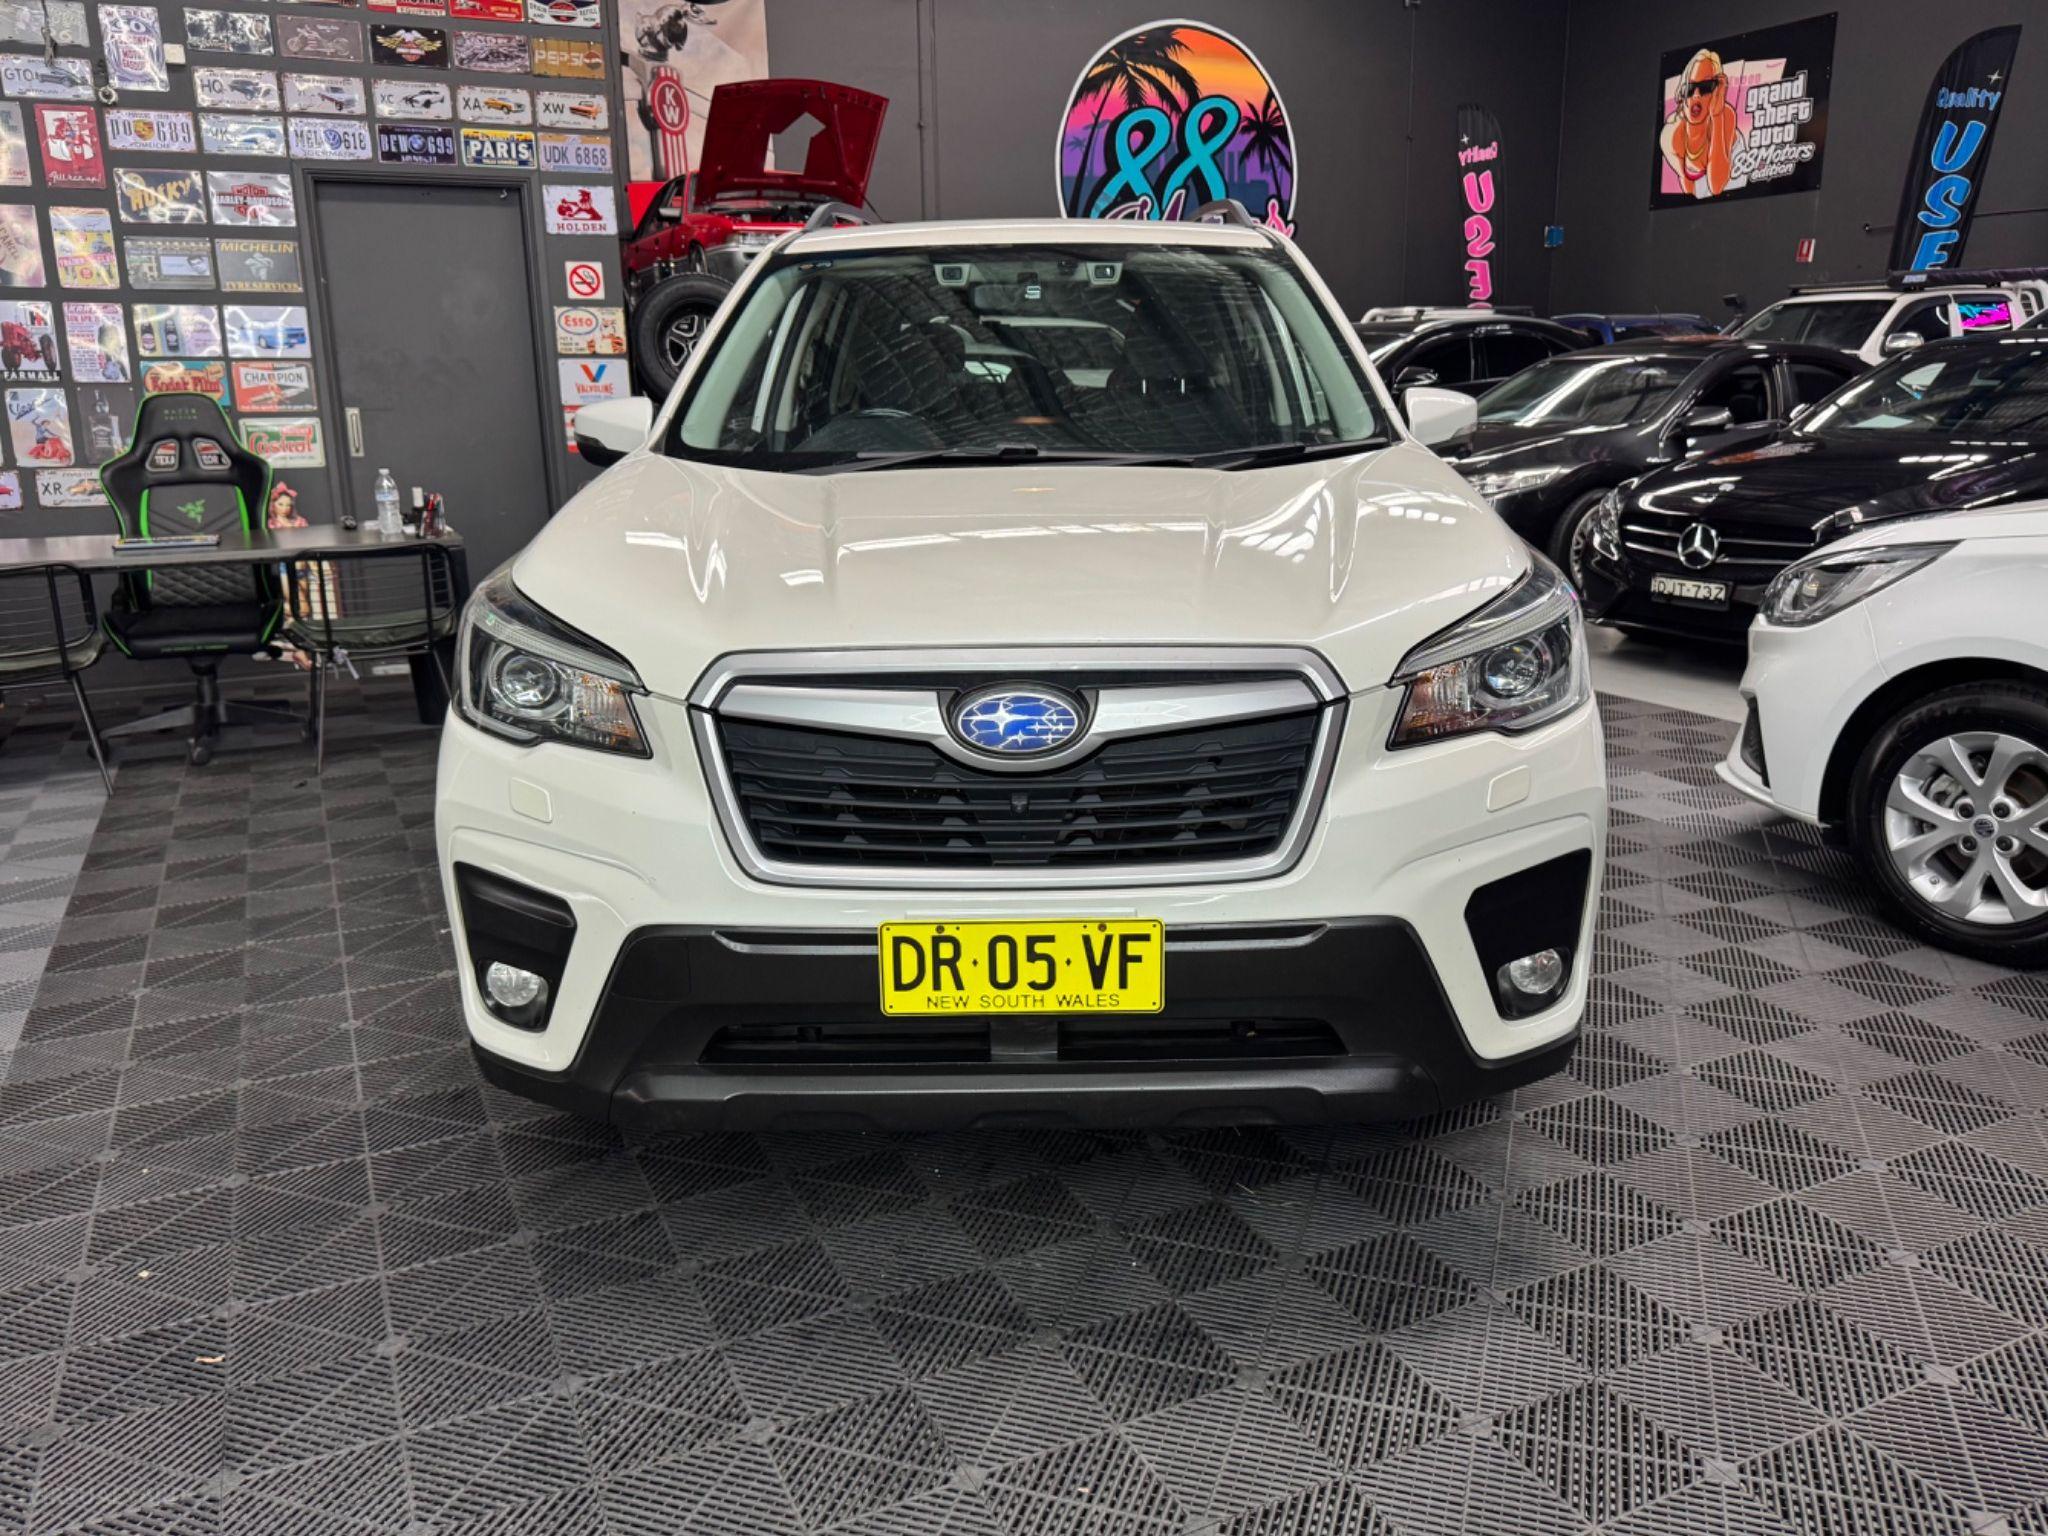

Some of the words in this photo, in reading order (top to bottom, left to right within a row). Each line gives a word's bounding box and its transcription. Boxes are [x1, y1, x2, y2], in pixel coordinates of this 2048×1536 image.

[535, 50, 584, 66] PEPSI
[200, 79, 223, 94] HQ
[380, 94, 395, 105] XC
[462, 97, 482, 111] XA
[1936, 86, 2001, 111] Quality
[543, 102, 566, 114] XW
[156, 120, 192, 143] 689
[470, 139, 530, 160] PARIS
[543, 145, 570, 165] UDK
[575, 147, 608, 167] 6868
[127, 178, 191, 212] HUSKY
[556, 222, 608, 232] HOLDEN
[220, 242, 294, 254] MICHELIN
[4, 371, 60, 381] FARMALL
[243, 371, 305, 384] CHAMPION
[575, 382, 614, 395] VALVOLINE
[41, 482, 63, 496] XR
[927, 995, 970, 1009] NEW
[980, 994, 1045, 1008] SOUTH
[1057, 993, 1120, 1008] WALES
